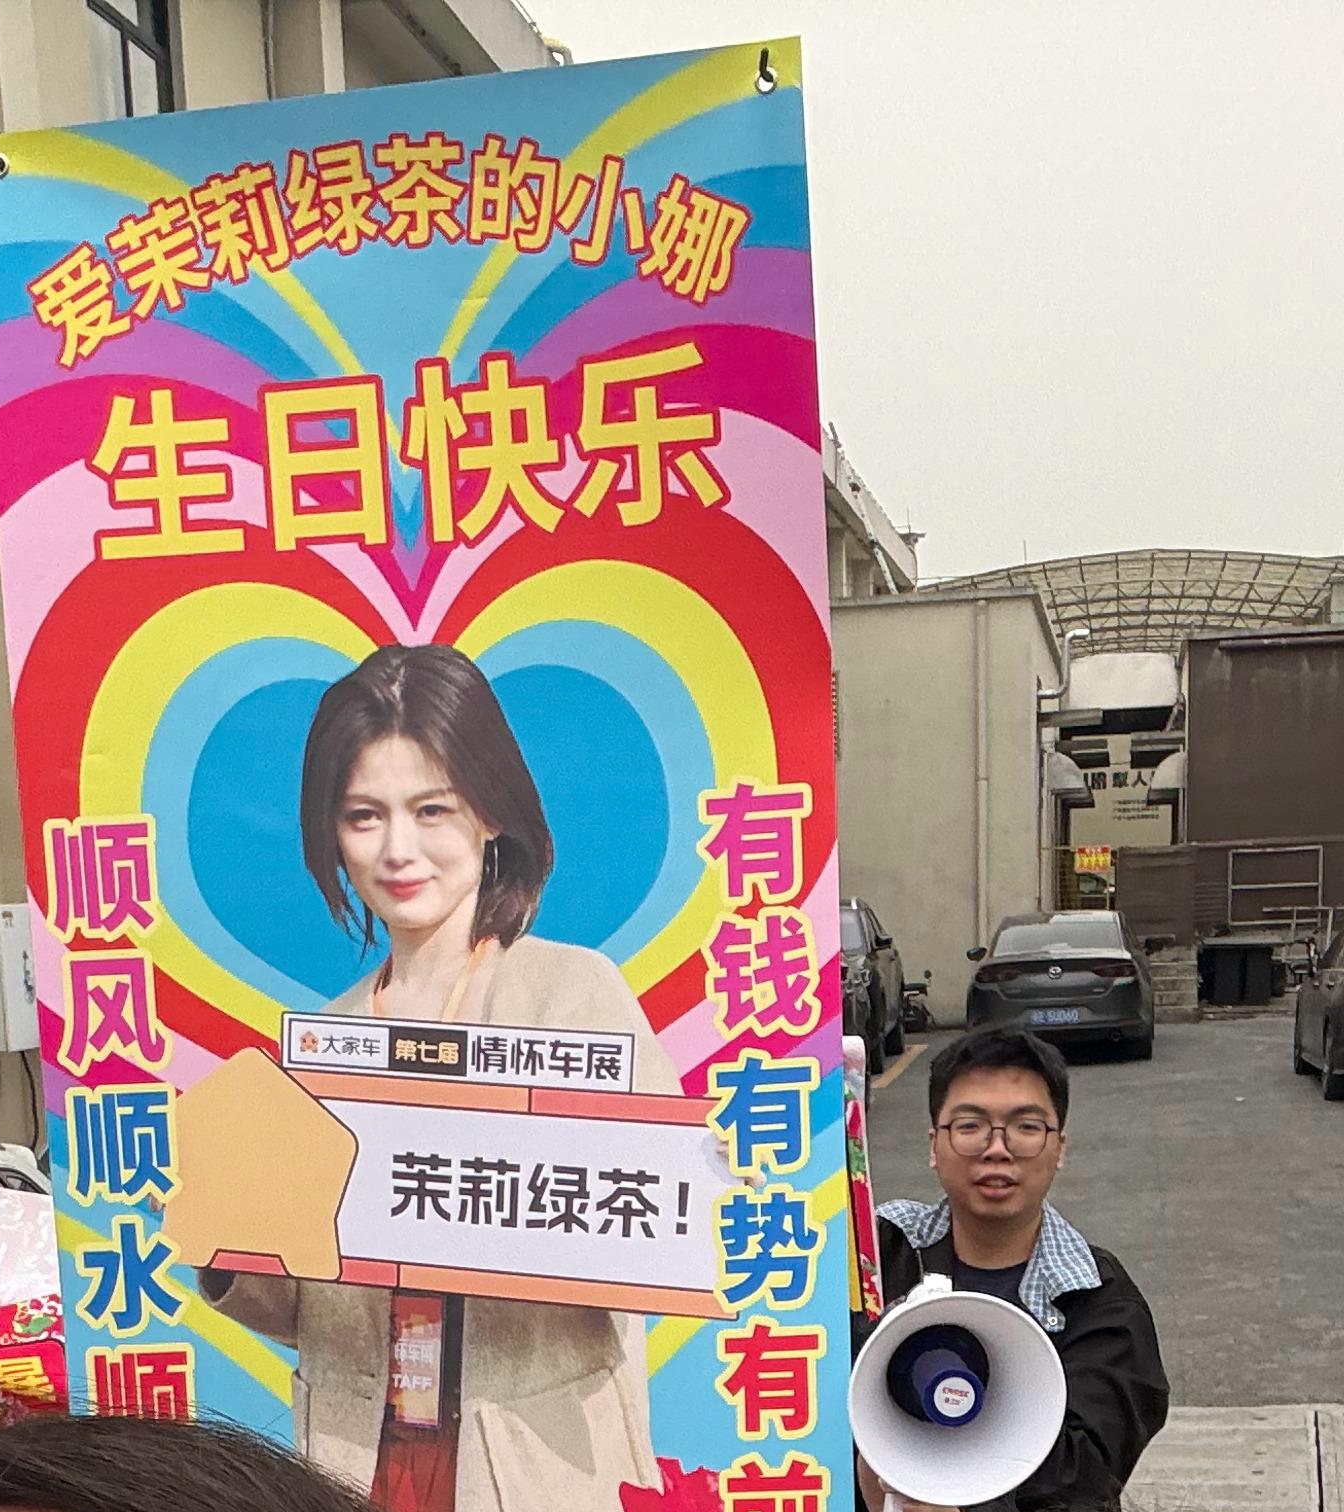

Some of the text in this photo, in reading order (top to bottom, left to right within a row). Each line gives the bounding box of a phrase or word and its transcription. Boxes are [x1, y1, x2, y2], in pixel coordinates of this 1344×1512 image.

[29, 133, 750, 368] 爱茉莉绿茶的小娜
[92, 342, 728, 561] 生日快乐
[322, 1034, 623, 1082] 大家车 第七届 情怀车展
[390, 1151, 691, 1239] 茉莉绿茶！
